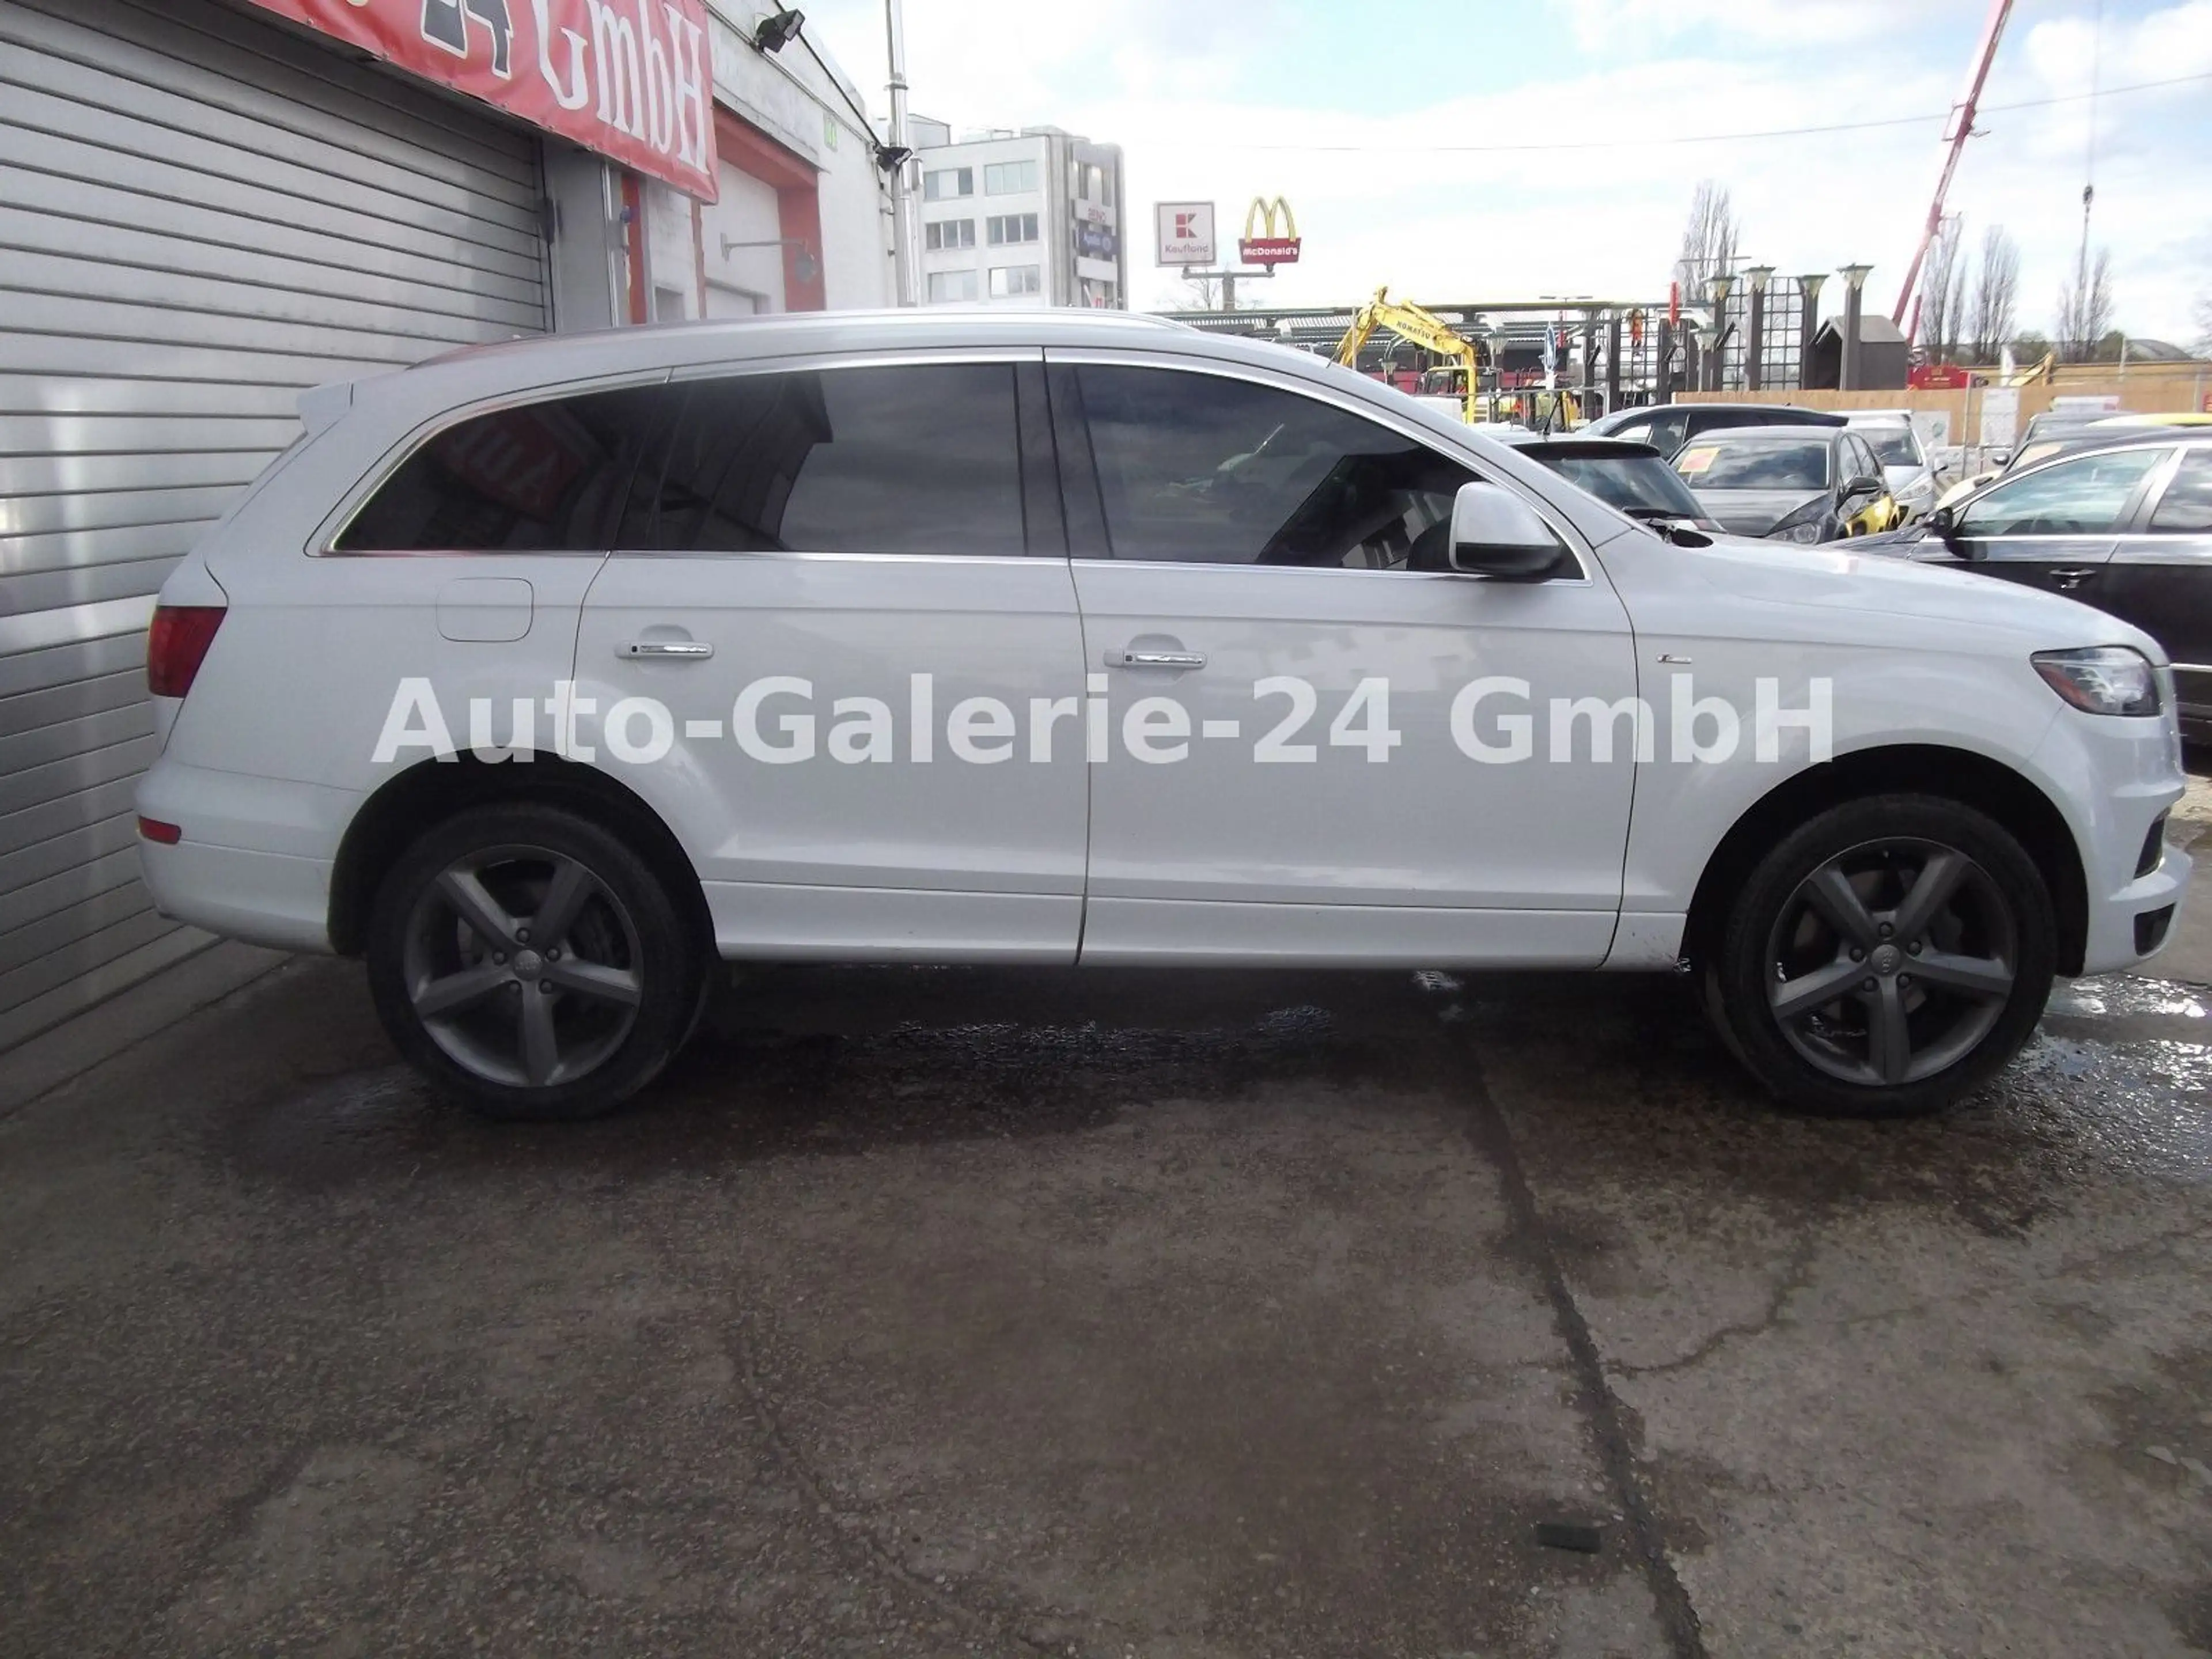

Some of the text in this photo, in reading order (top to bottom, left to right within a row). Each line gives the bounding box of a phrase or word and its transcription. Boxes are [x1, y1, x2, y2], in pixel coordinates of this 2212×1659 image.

[532, 0, 710, 175] GmbH
[1165, 243, 1209, 254] Kaufland
[1243, 246, 1298, 256] McDonald's
[1396, 320, 1431, 340] KOMATSU
